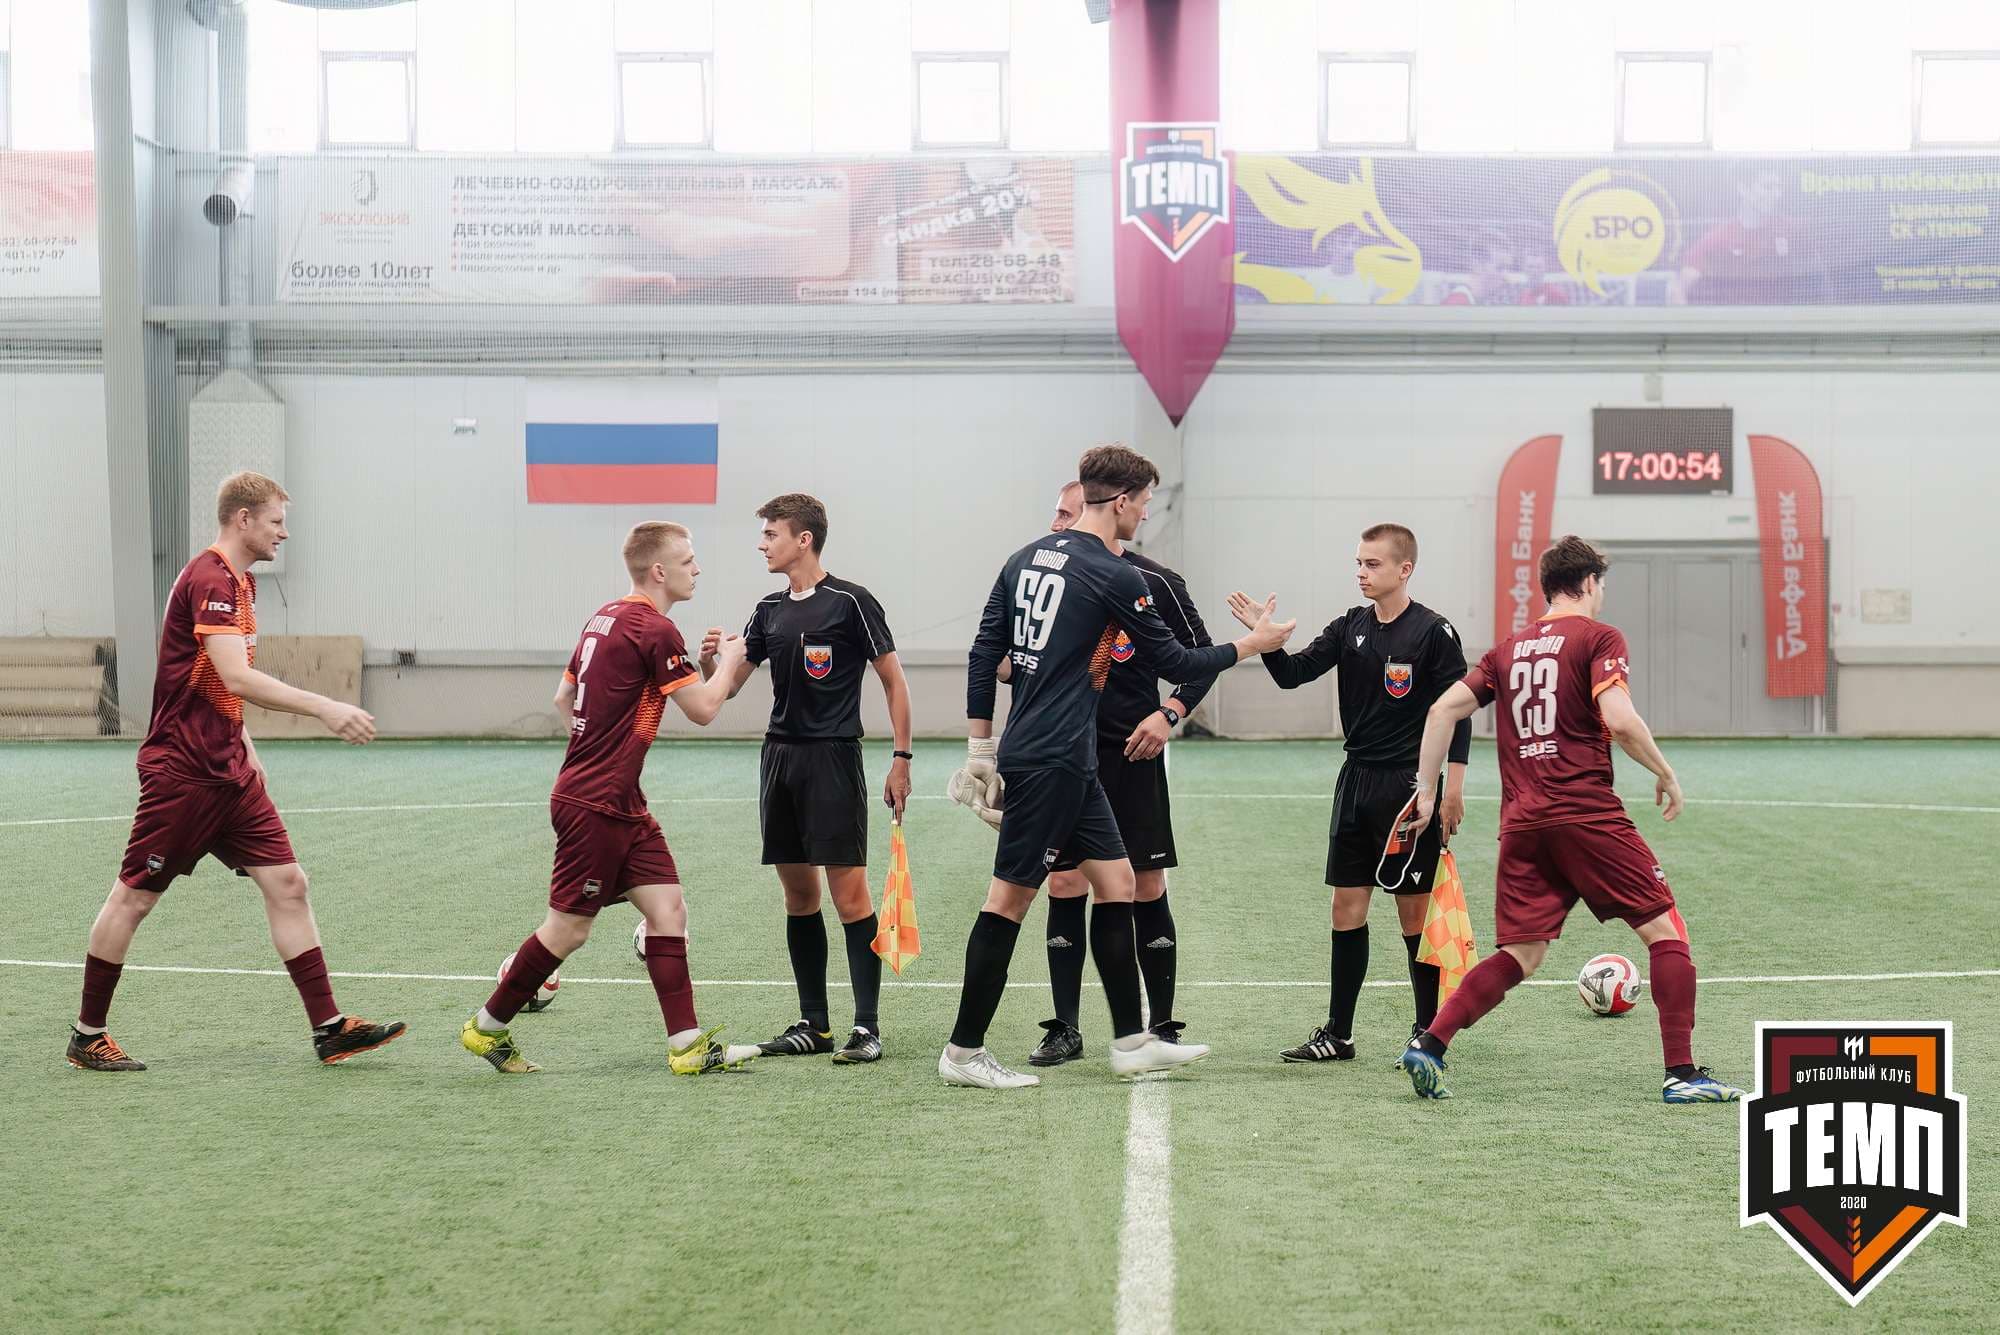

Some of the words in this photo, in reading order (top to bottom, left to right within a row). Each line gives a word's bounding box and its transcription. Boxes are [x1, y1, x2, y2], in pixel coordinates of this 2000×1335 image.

[452, 174, 745, 191] ЛЕЧЕБНО-ОЗДОРОВИТЕЛЬНЫЙ
[1131, 161, 1218, 209] ТЕМП
[1881, 170, 2000, 192] побеждат
[981, 183, 1041, 217] 20%
[452, 219, 542, 239] ДЕТСКИЙ
[290, 259, 361, 279] более
[1598, 451, 1722, 480] 17:00:54
[1511, 489, 1537, 561] Банк
[1013, 568, 1066, 651] 59
[1509, 657, 1559, 740] 23
